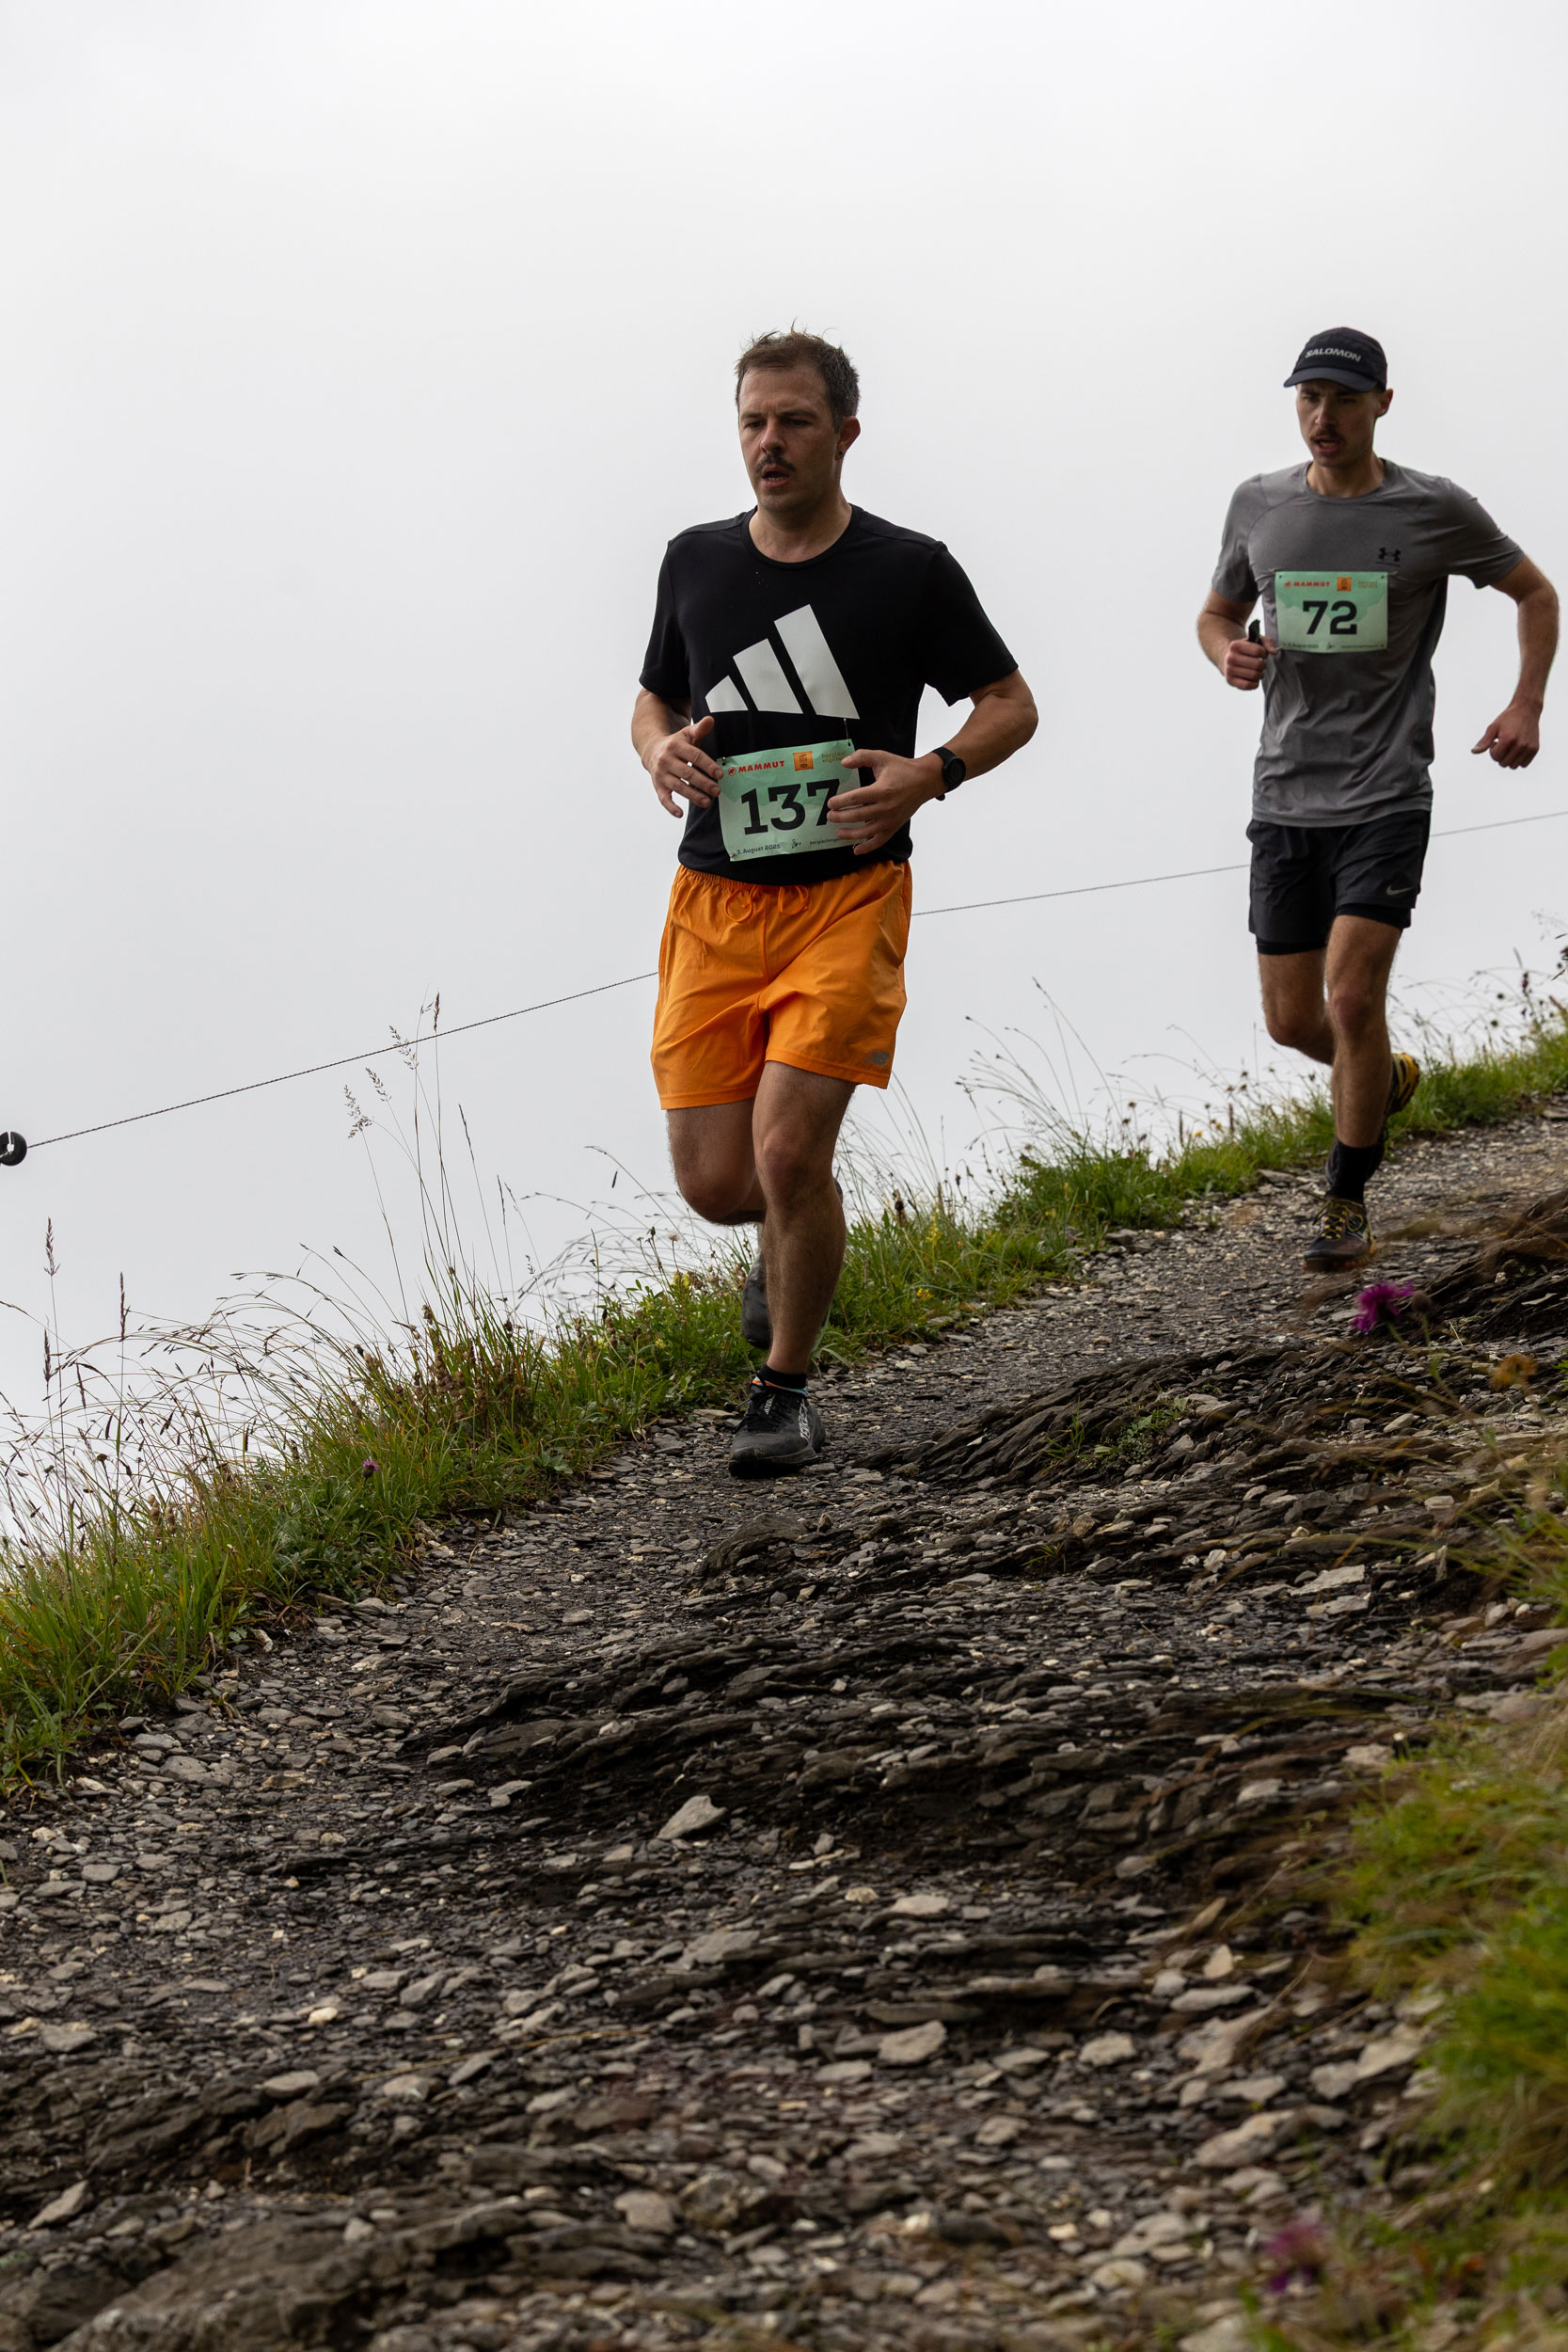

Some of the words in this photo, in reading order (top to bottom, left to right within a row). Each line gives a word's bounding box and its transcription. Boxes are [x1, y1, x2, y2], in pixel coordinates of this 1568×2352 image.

[1305, 347, 1362, 362] SALOMON
[1303, 600, 1357, 635] 72
[738, 760, 785, 773] MAMMUT
[741, 779, 840, 835] 137
[743, 846, 764, 854] August
